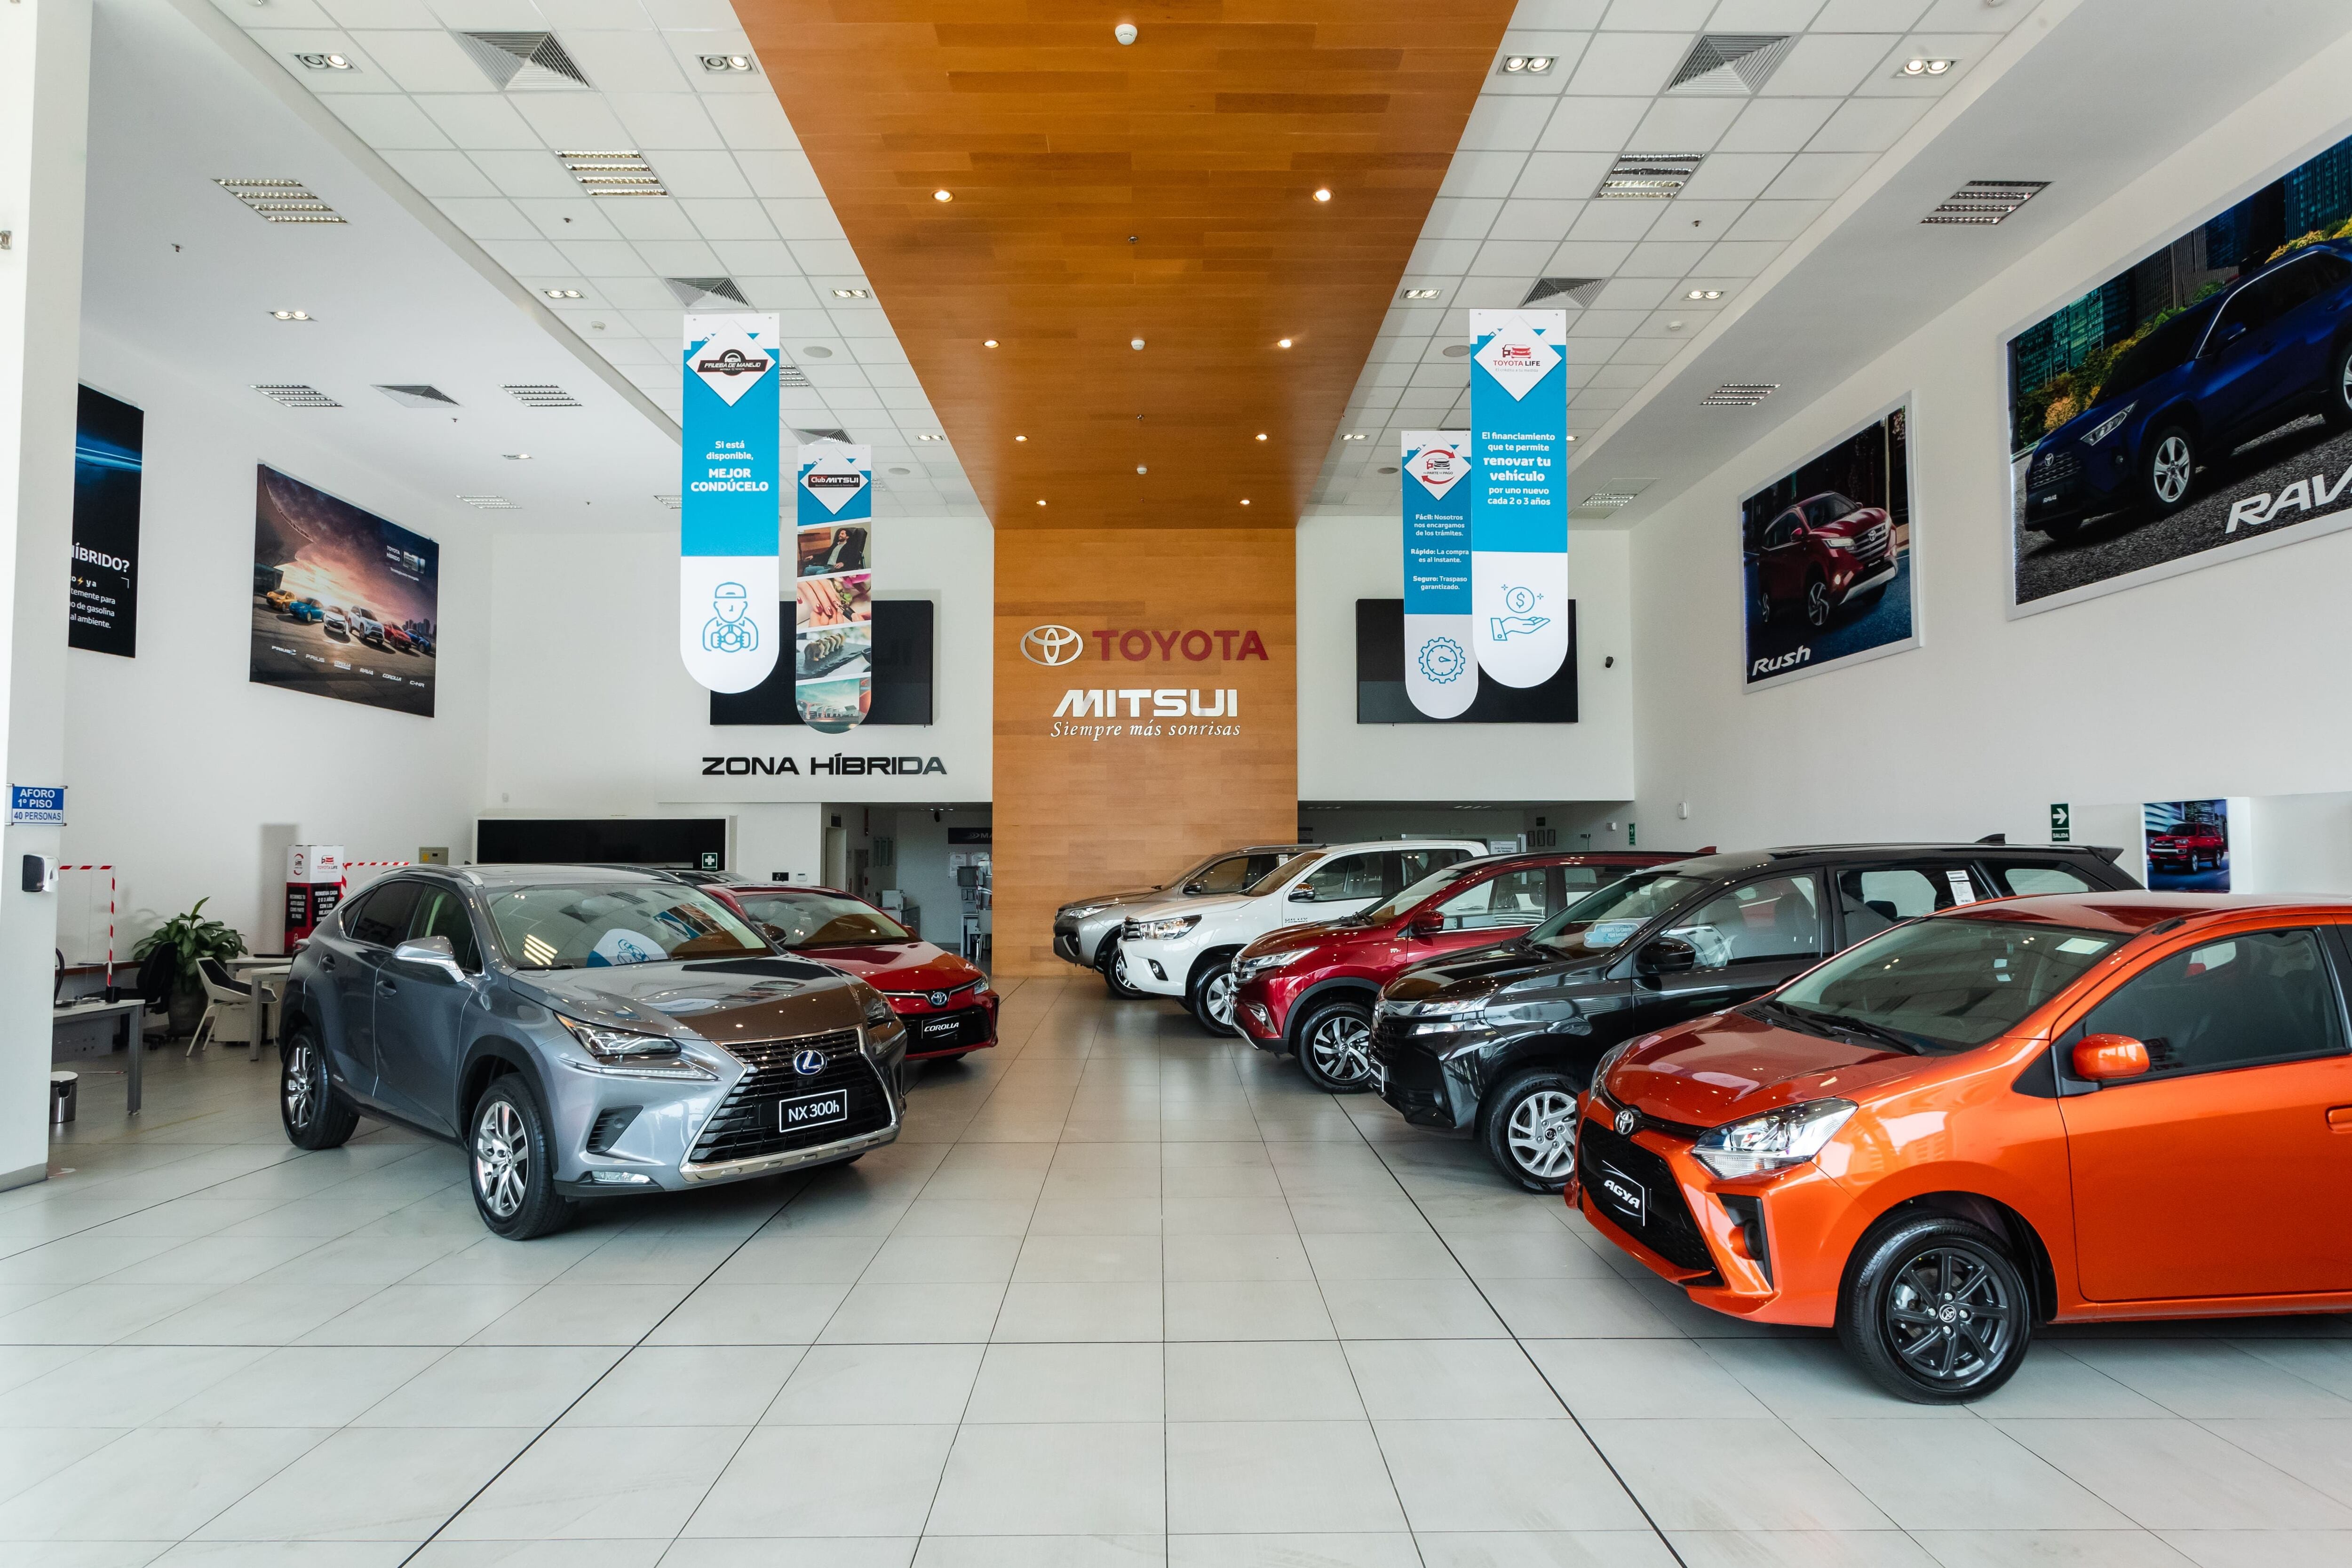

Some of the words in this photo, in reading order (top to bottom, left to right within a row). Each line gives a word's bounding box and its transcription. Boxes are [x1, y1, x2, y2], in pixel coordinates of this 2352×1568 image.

[1492, 432, 1555, 441] financiamiento
[725, 440, 745, 449] está
[1516, 444, 1549, 453] permite
[706, 452, 754, 461] disponible,
[1483, 457, 1534, 467] renovar
[1537, 456, 1551, 467] tu
[708, 468, 751, 478] MEJOR
[1490, 470, 1545, 481] vehículo
[691, 479, 769, 492] CONDÚCELO
[1489, 487, 1504, 496] por
[1530, 497, 1550, 506] años
[2225, 464, 2352, 534] RAV
[387, 545, 400, 555] TOYOTA
[100, 596, 116, 605] para
[77, 602, 86, 610] de
[87, 605, 115, 617] gasolina
[77, 615, 111, 629] ambiente.
[1092, 630, 1269, 661] TOYOTA
[306, 654, 325, 662] PRIUS
[1752, 645, 1811, 676] Rush
[382, 673, 402, 682] COROLLA
[1053, 689, 1238, 717] MITSUI
[1050, 721, 1122, 741] Siempre
[1129, 719, 1161, 736] más
[1168, 721, 1241, 736] sonrisas
[702, 757, 800, 775] ZONA
[810, 753, 946, 775] HÍBRIDA
[20, 788, 56, 798] AFORO
[29, 799, 53, 808] PISO
[25, 812, 61, 820] PERSONAS
[924, 1022, 959, 1032] COROLLA
[788, 1106, 809, 1122] NX
[810, 1100, 839, 1117] 300h
[1604, 1180, 1640, 1209] AGYA
